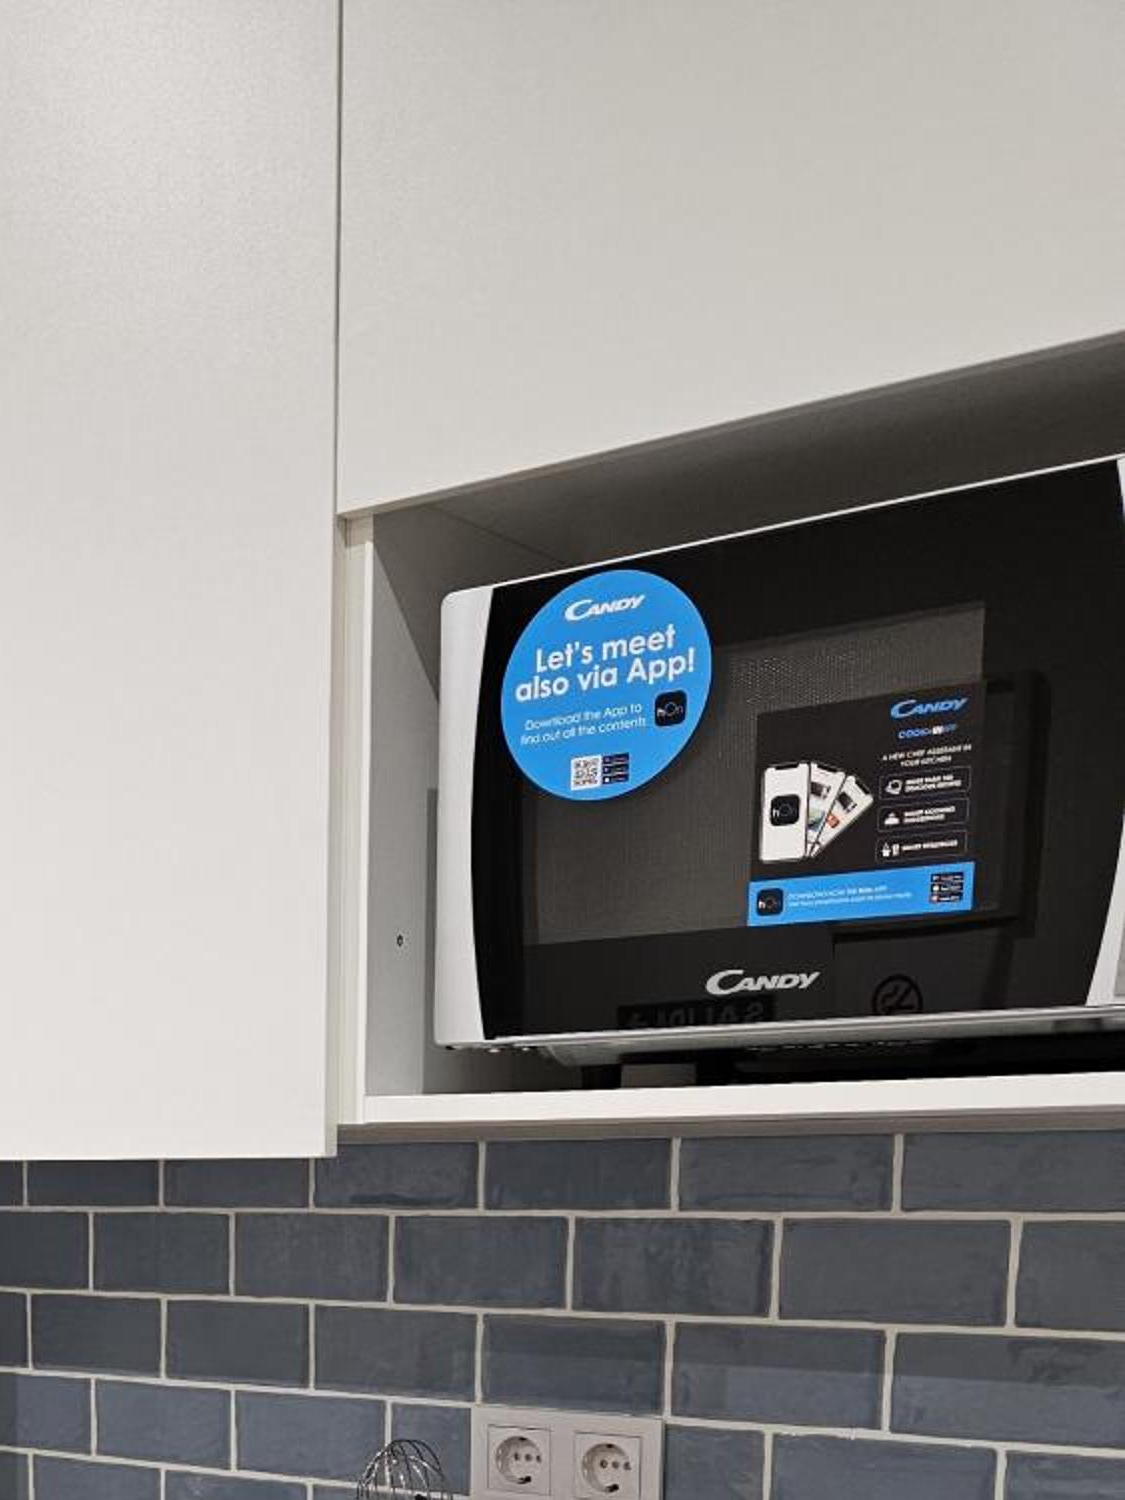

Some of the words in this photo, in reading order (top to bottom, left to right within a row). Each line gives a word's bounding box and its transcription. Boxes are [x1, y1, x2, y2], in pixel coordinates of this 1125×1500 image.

[564, 595, 645, 621] CANDY
[536, 642, 593, 673] Let's
[602, 624, 676, 661] meet
[515, 674, 570, 701] also
[577, 665, 617, 691] via
[627, 647, 695, 684] App!
[525, 710, 581, 731] Download
[603, 706, 628, 719] App
[631, 704, 643, 713] to
[891, 698, 968, 718] CANDY
[563, 726, 576, 738] all
[578, 724, 596, 736] the
[706, 969, 821, 995] CANDY
